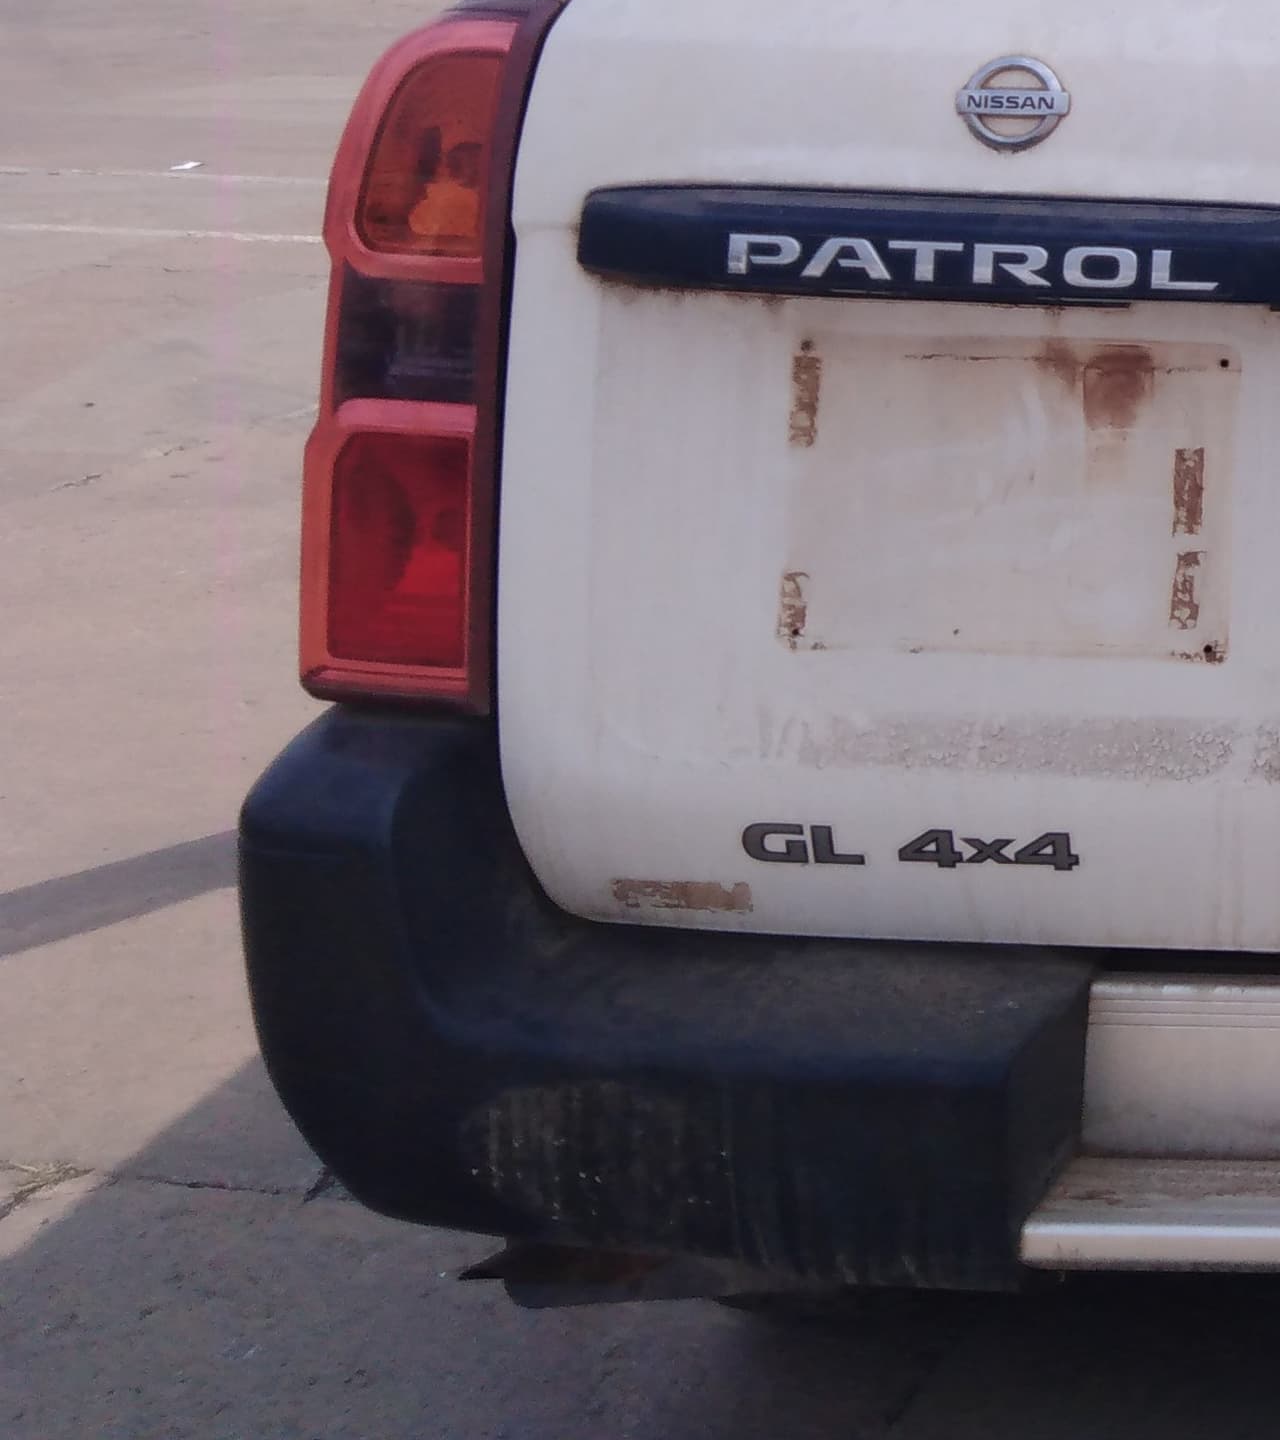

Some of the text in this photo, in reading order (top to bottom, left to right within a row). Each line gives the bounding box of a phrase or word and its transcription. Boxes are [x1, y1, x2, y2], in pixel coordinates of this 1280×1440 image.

[966, 94, 1055, 110] NISSAN
[727, 233, 1220, 291] PATROL
[740, 822, 1081, 872] GL 4x4
